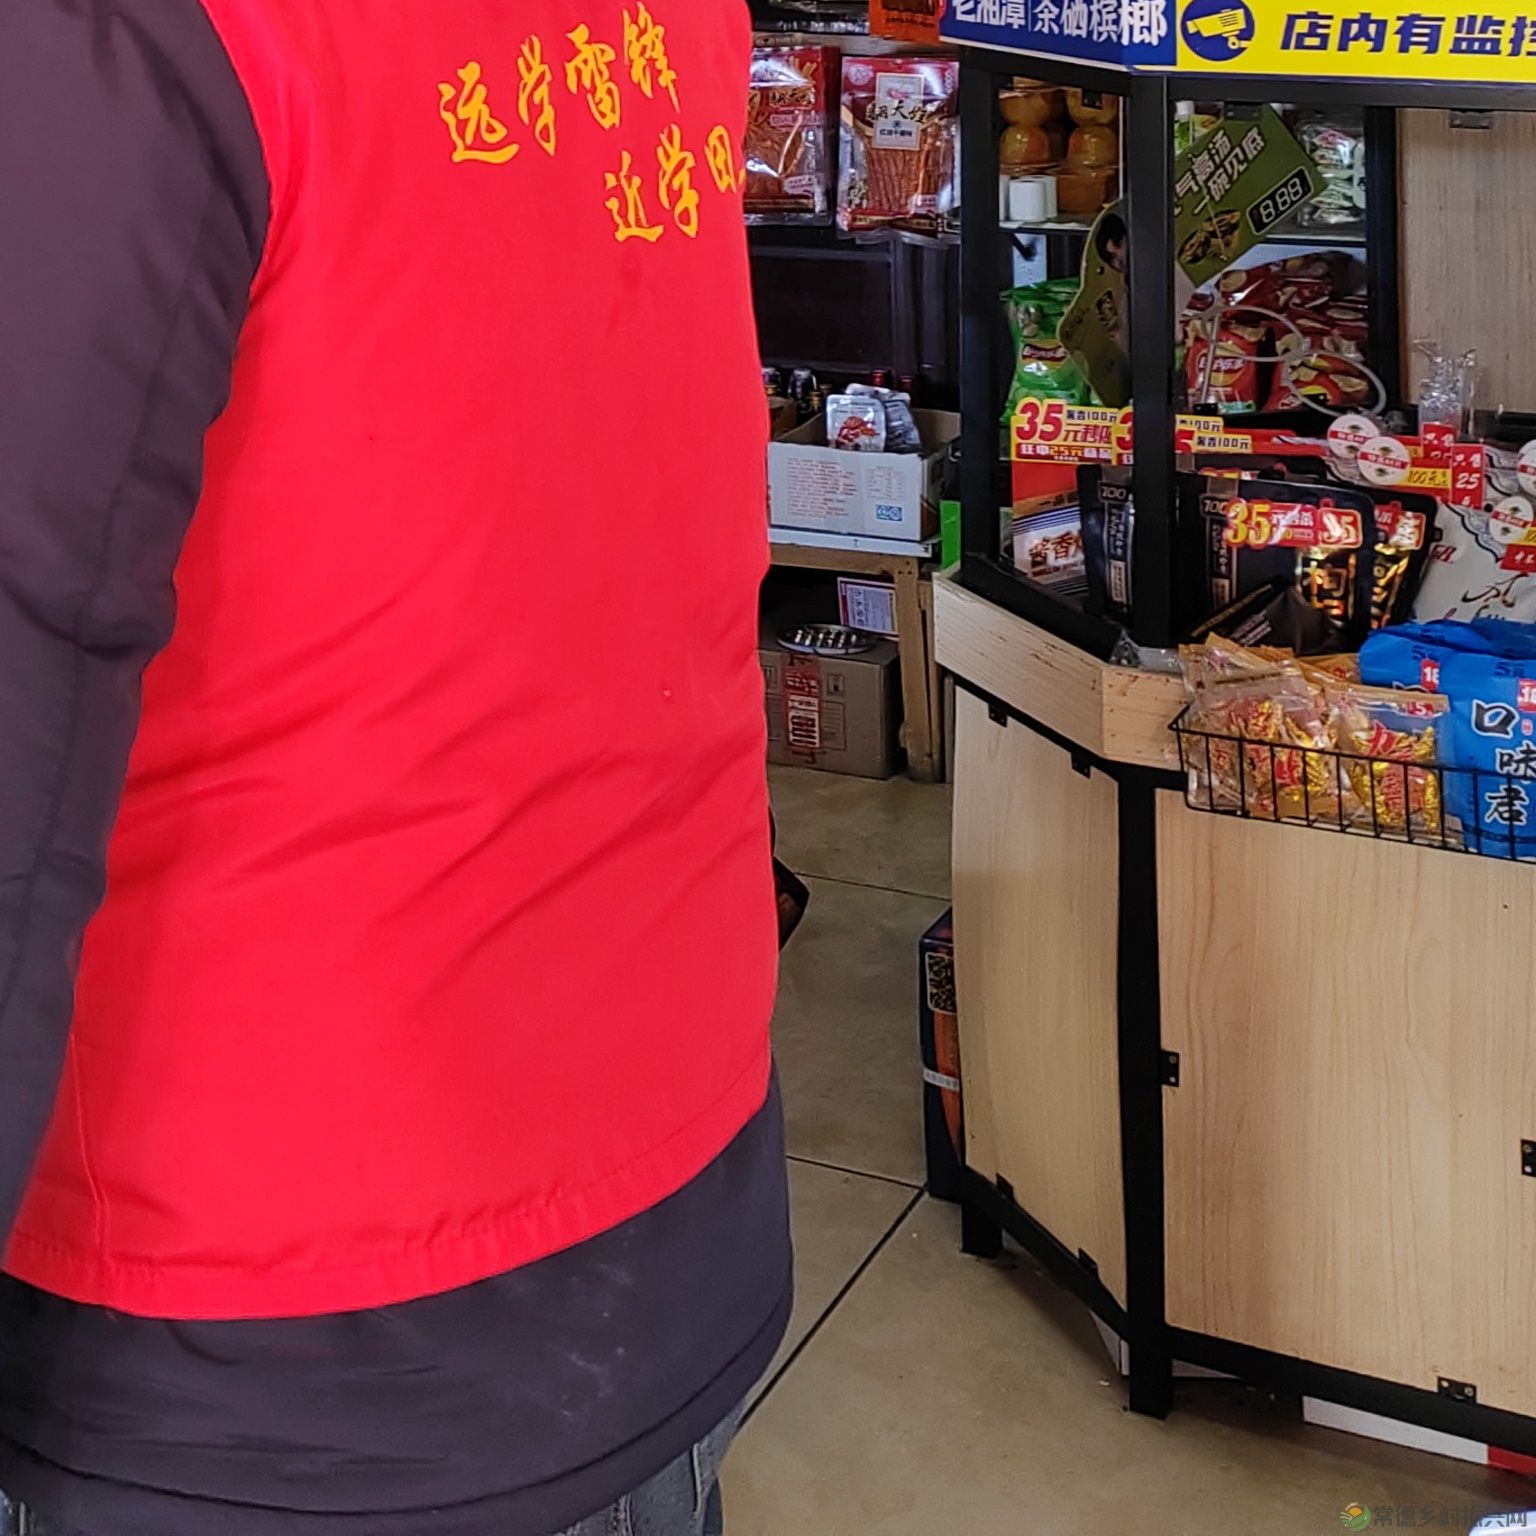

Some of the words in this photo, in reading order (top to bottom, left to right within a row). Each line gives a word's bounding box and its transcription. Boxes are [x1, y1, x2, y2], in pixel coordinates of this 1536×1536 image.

[437, 0, 682, 164] 远学雷锋
[1193, 127, 1266, 215] 一碗见底
[1015, 401, 1065, 443] 35
[1227, 502, 1271, 546] 35
